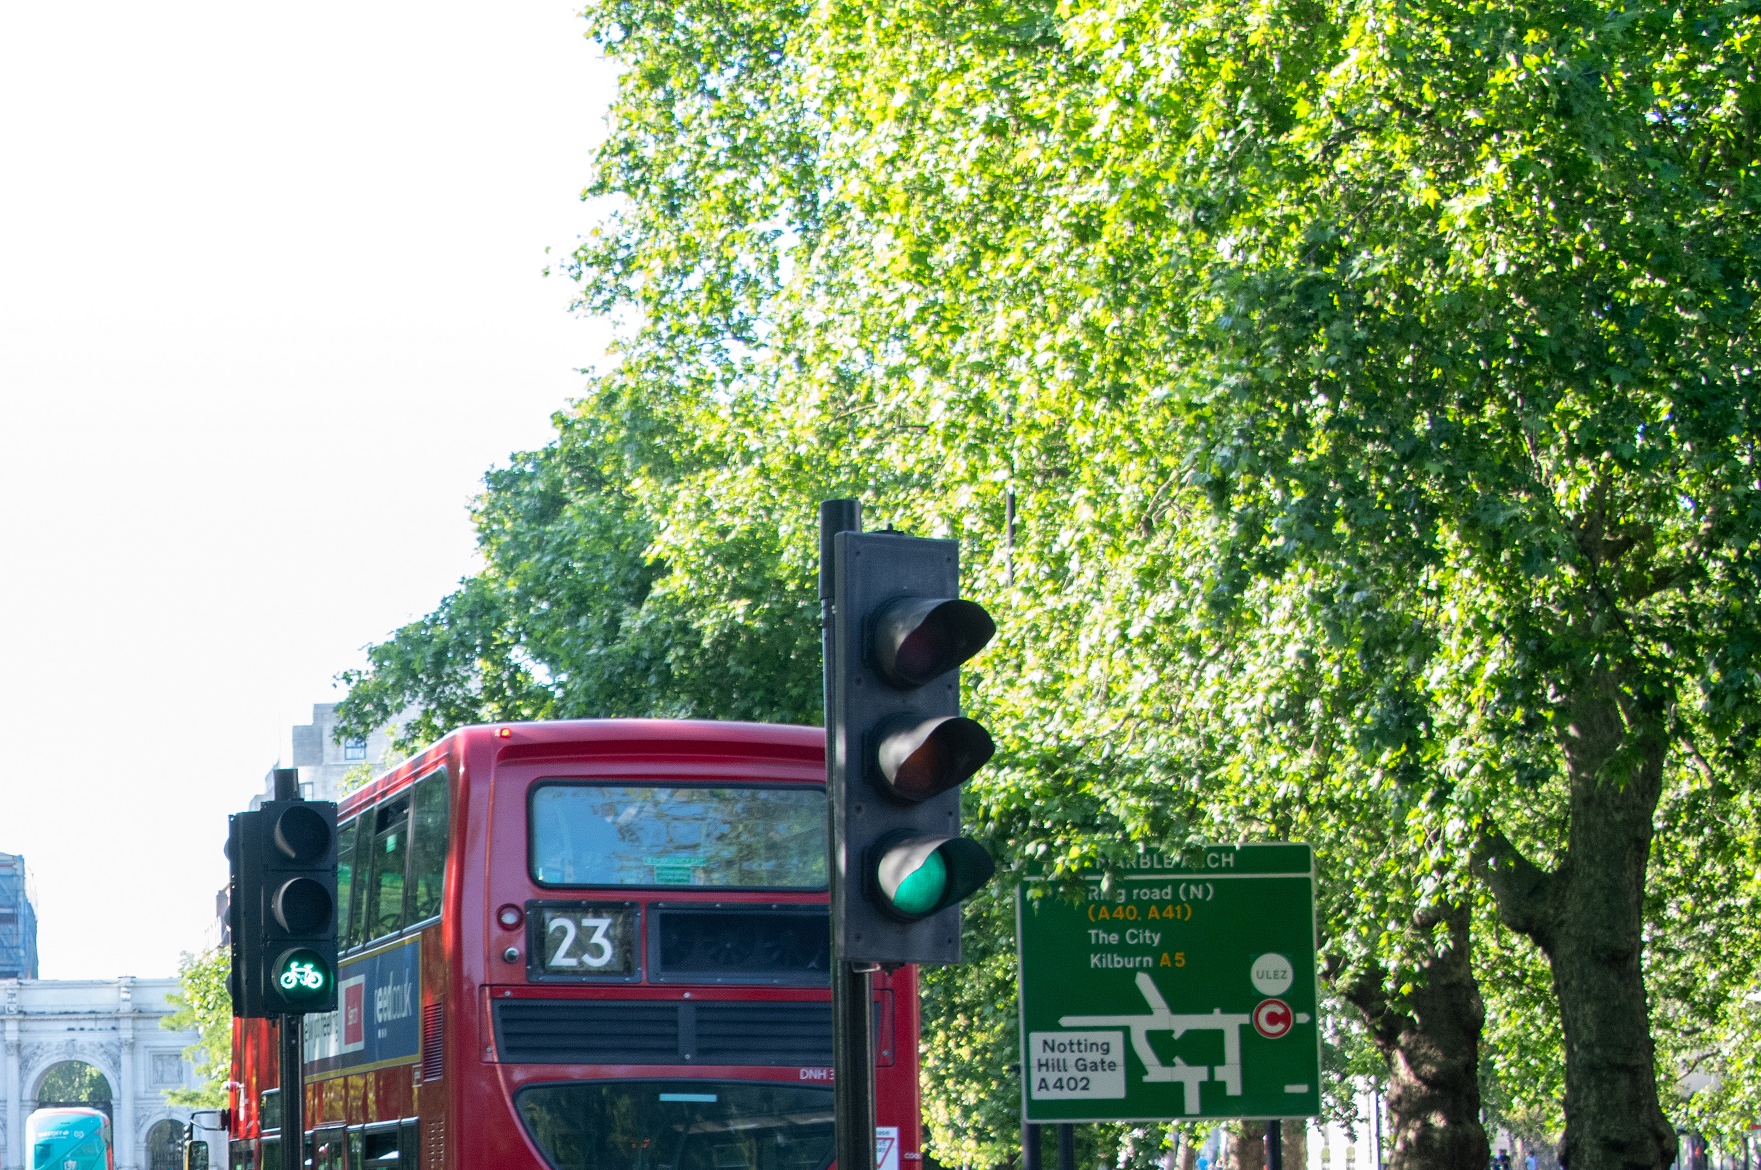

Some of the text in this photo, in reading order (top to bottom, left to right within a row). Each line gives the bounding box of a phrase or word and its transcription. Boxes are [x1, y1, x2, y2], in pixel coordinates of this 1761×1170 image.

[1132, 884, 1172, 900] road
[1179, 882, 1214, 901] (N)
[1148, 903, 1192, 921] A41)
[548, 917, 613, 968] 23
[1088, 928, 1161, 946] The City
[1090, 953, 1153, 968] Kilburn
[1256, 969, 1288, 980] ULEZ
[1042, 1039, 1110, 1055] Notting
[1037, 1057, 1117, 1073] Hill Gate
[799, 1069, 827, 1080] DNH
[1037, 1076, 1090, 1092] A402
